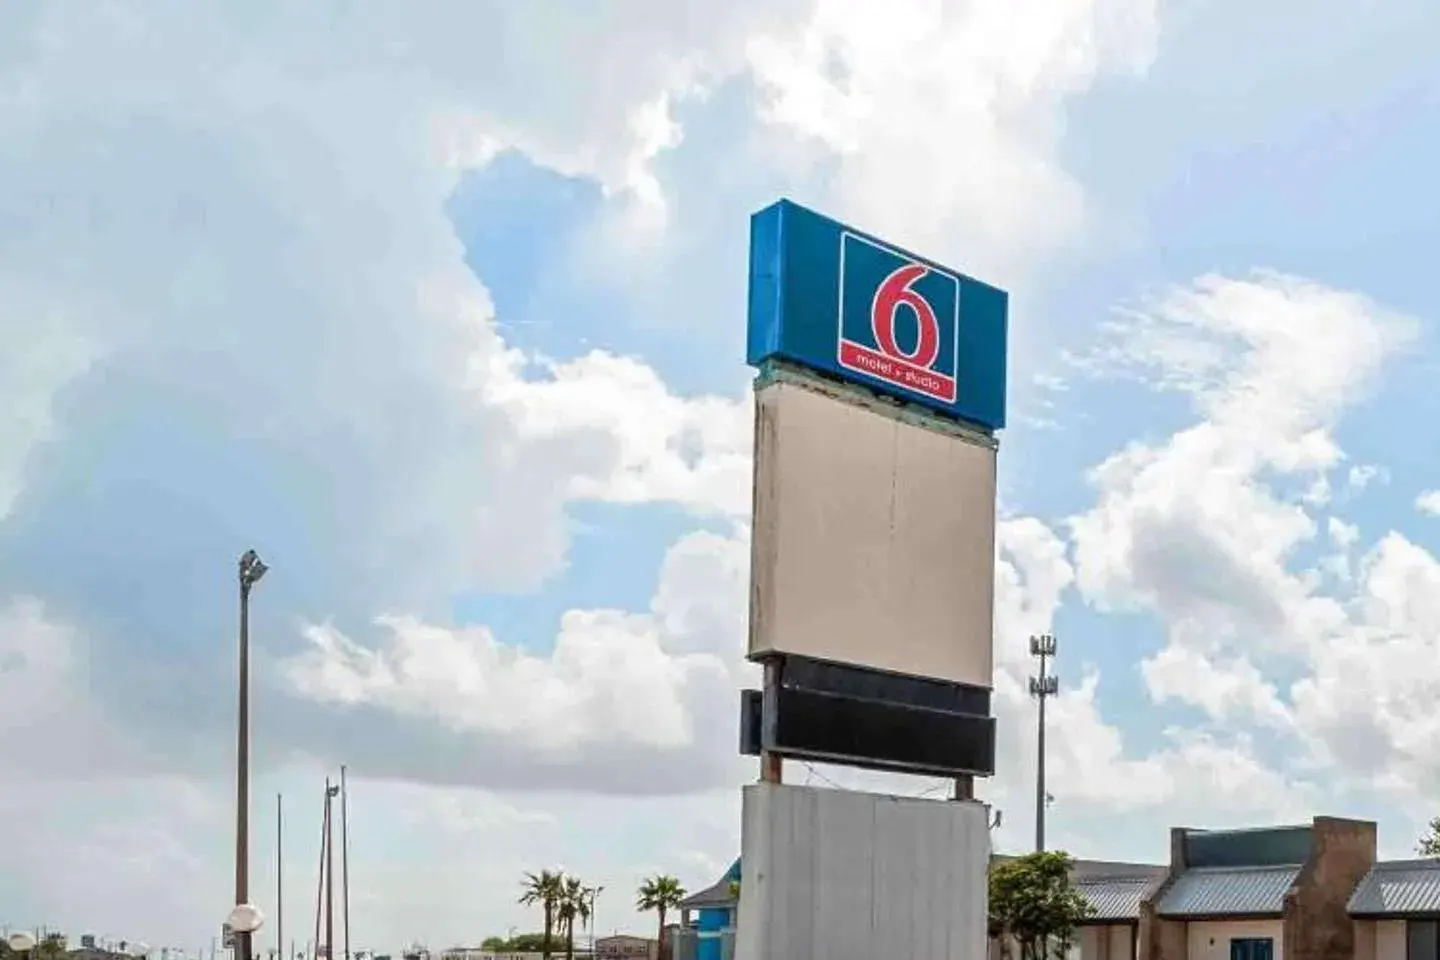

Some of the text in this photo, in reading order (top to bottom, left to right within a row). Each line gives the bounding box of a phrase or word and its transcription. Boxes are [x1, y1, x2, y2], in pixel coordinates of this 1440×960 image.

[871, 262, 939, 369] 6
[856, 354, 940, 391] motel studio
